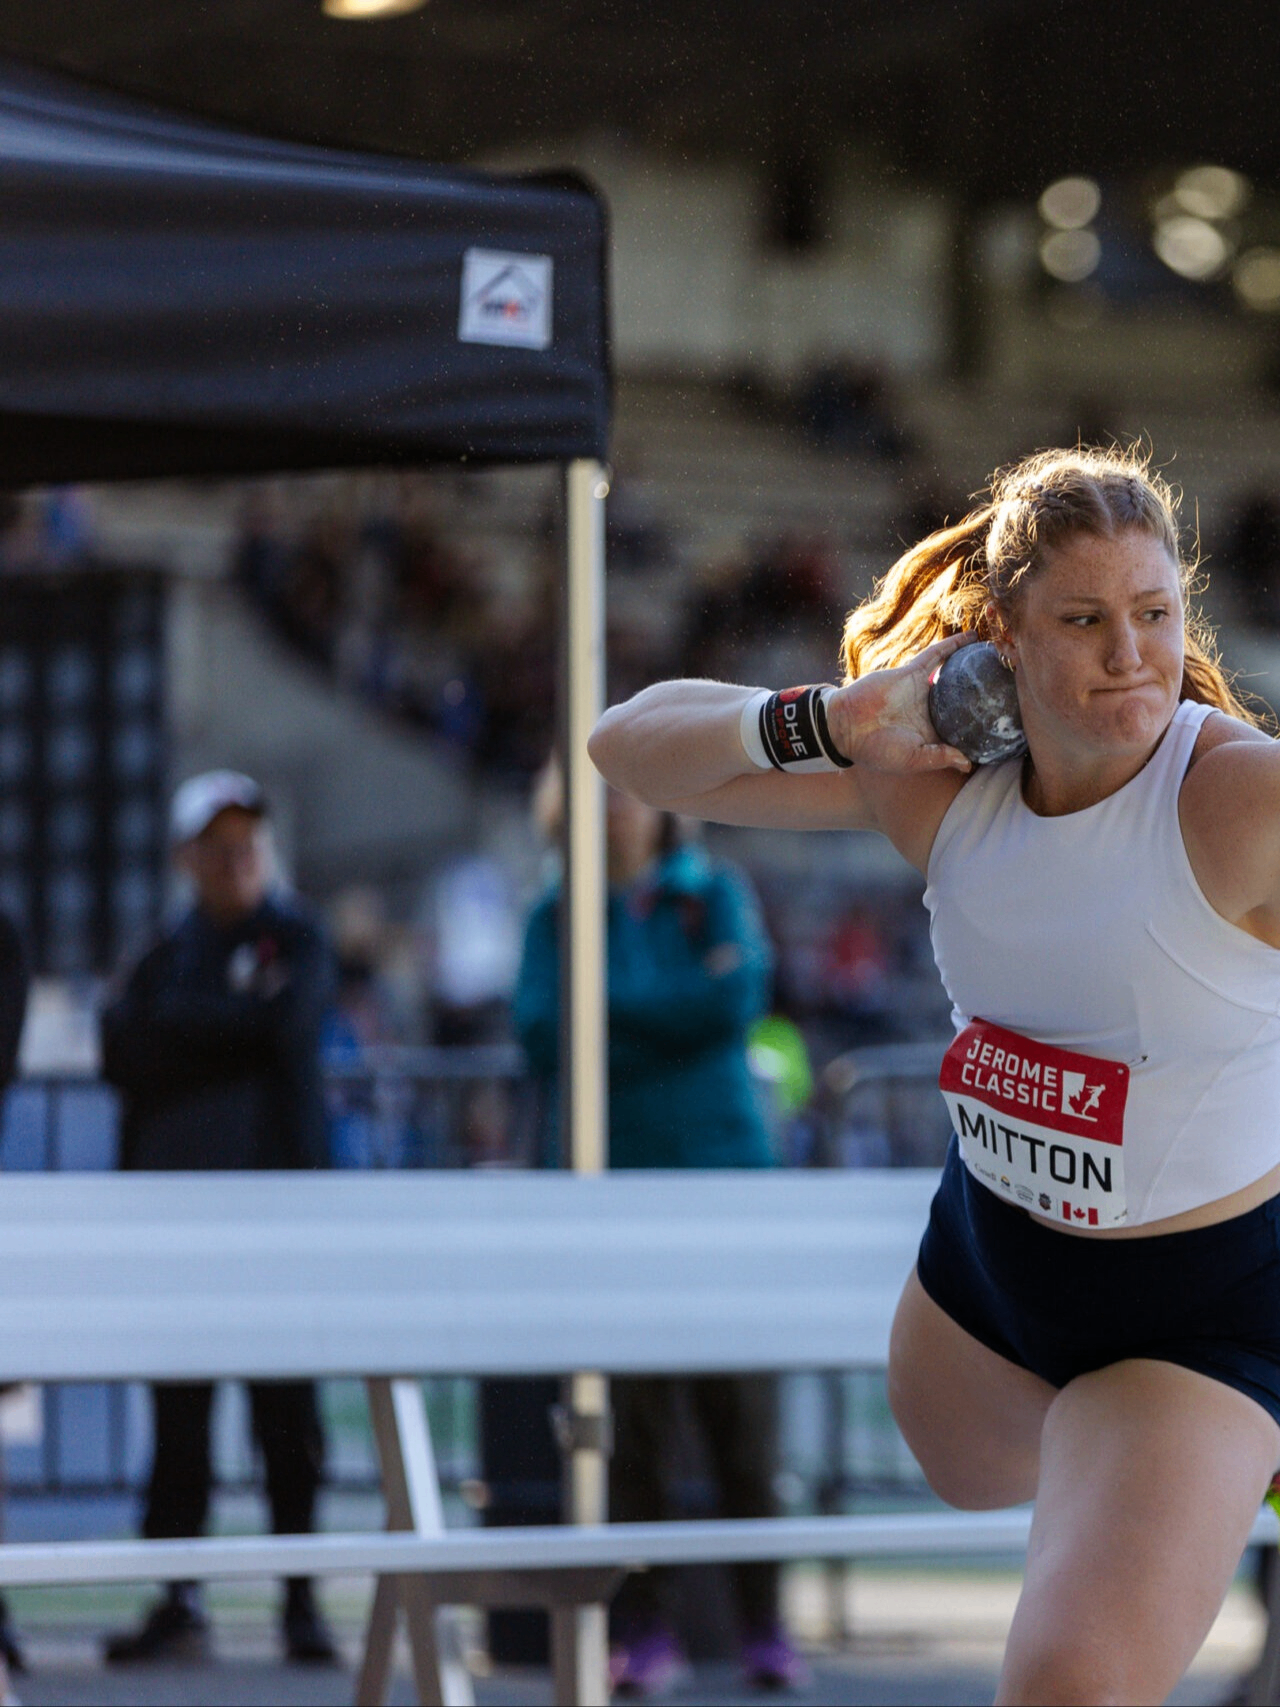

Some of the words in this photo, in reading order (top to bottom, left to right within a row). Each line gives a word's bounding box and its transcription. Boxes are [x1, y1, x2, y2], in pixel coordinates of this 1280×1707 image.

[784, 703, 808, 756] DHE
[961, 1063, 1057, 1112] CLASSIC
[966, 1039, 1058, 1088] JEROME
[957, 1103, 1112, 1193] MITTON
